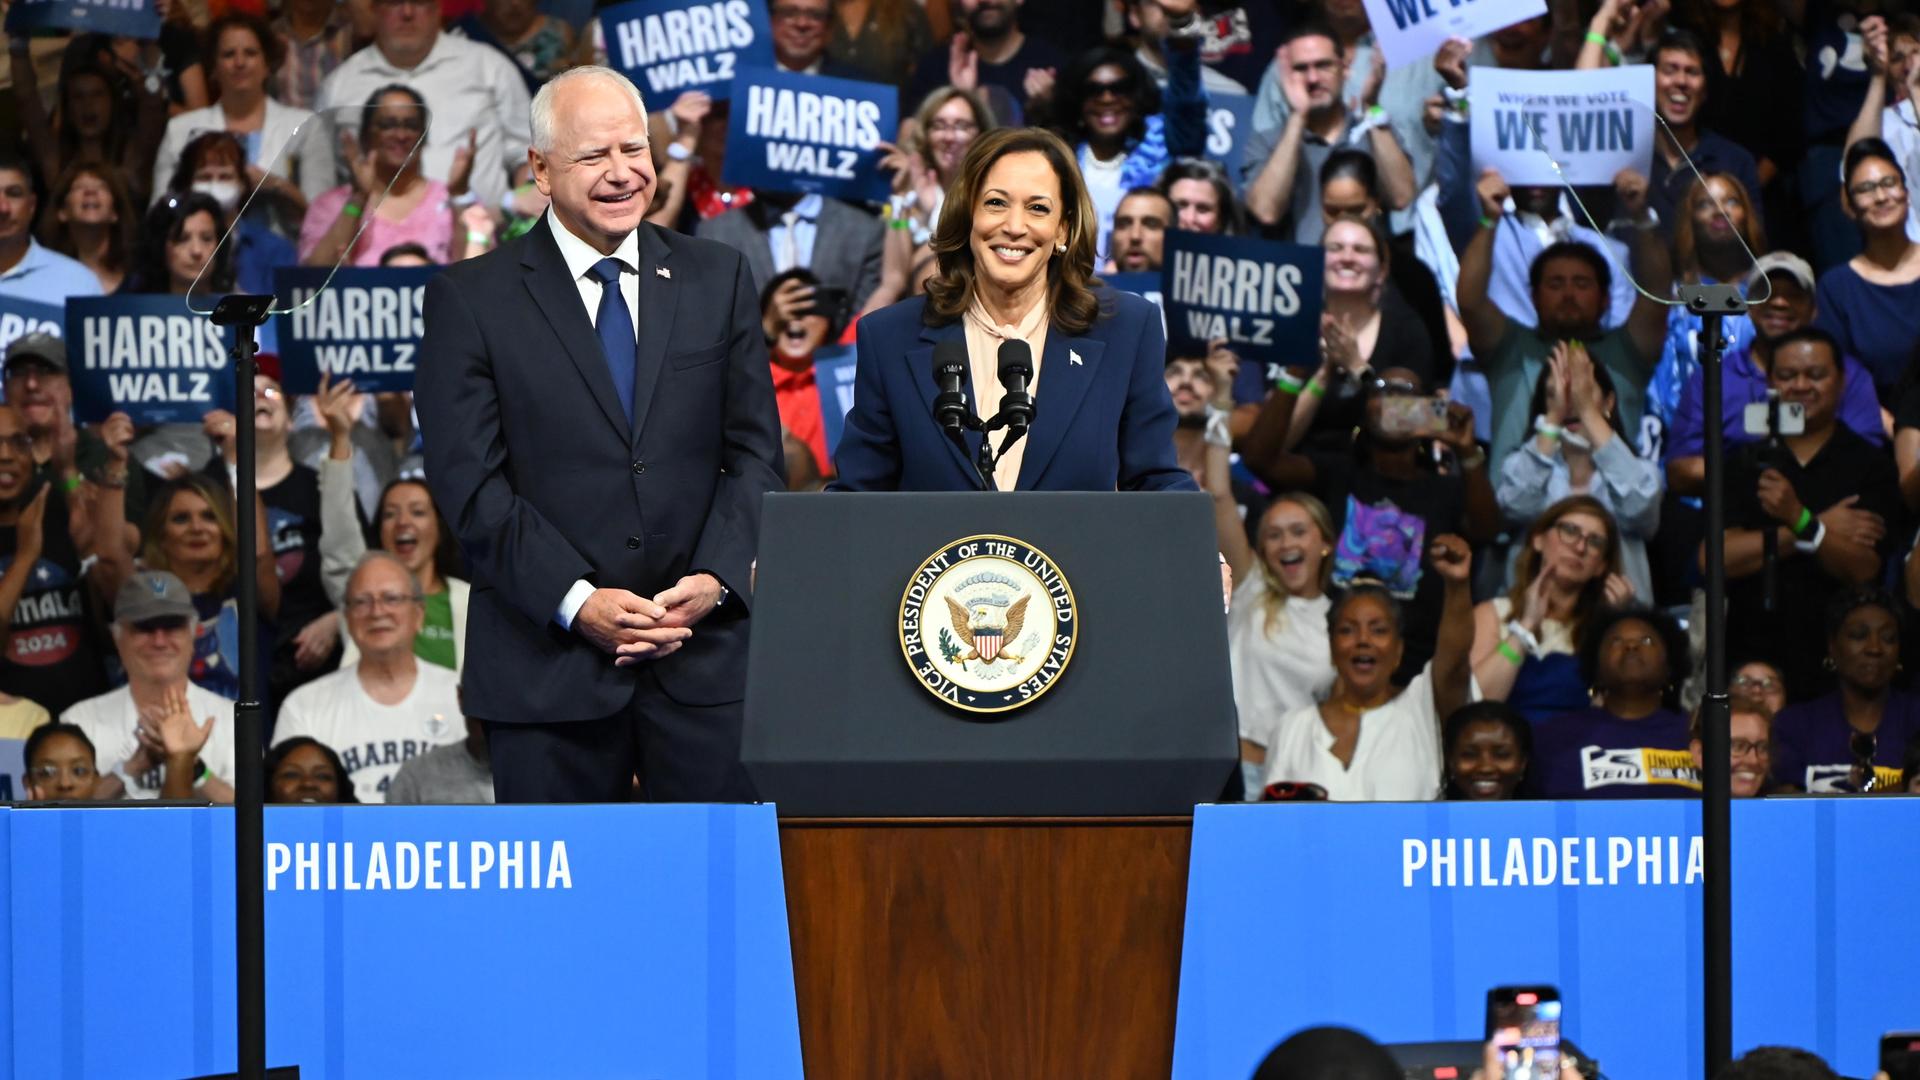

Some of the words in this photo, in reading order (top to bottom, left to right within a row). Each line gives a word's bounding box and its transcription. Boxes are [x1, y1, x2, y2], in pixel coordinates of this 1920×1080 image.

[616, 0, 754, 68] HARRIS
[646, 51, 737, 92] WALZ
[746, 85, 881, 151] HARRIS
[1498, 92, 1549, 105] WHEN
[1554, 95, 1579, 106] WE
[1586, 90, 1630, 104] VOTE
[1494, 109, 1548, 151] WE
[1558, 109, 1634, 152] WIN
[767, 142, 858, 178] WALZ
[1172, 250, 1302, 316] HARRIS
[83, 316, 227, 369] HARRIS
[1187, 310, 1274, 345] WALZ
[314, 344, 415, 374] WALZ
[109, 373, 211, 403] WALZ
[958, 543, 979, 558] OF
[985, 542, 1017, 558] THE
[903, 552, 952, 656] PRESIDENT
[1024, 550, 1072, 622] UNITED
[16, 632, 67, 655] 2024
[919, 661, 959, 702] VICE
[1018, 634, 1071, 699] STATES
[1591, 768, 1640, 781] SEIU
[267, 841, 573, 891] PHILADELPHIA
[1403, 836, 1704, 887] PHILADELPHIA
